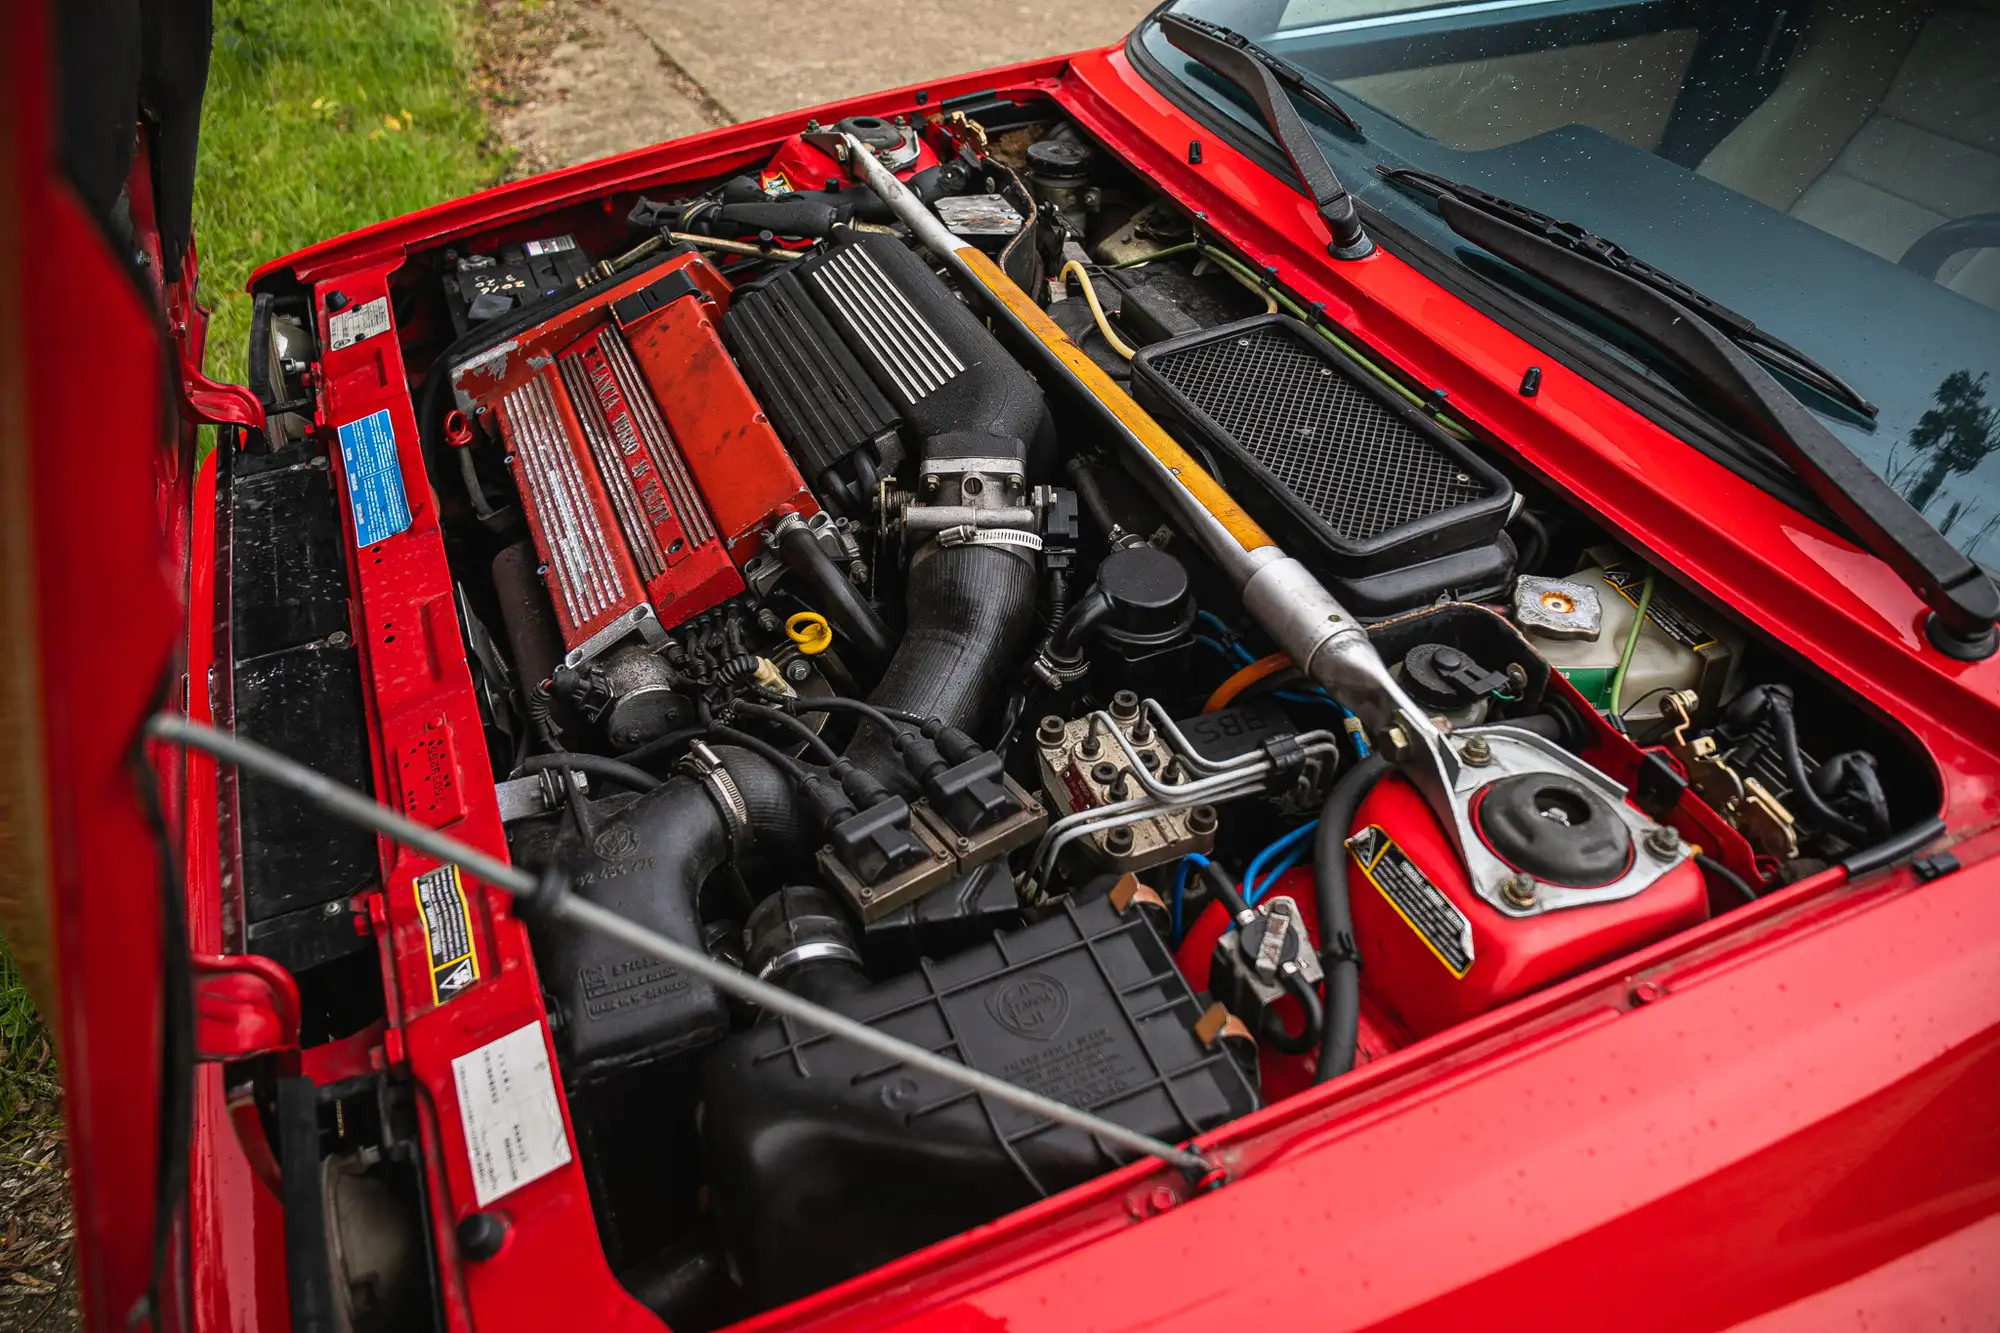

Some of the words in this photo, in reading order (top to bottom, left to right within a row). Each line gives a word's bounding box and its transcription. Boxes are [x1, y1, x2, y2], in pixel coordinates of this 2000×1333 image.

[480, 280, 526, 295] 2016
[589, 363, 619, 411] LANCIA
[611, 412, 639, 456] TURBO
[631, 459, 650, 478] 16
[642, 479, 671, 526] VALVE
